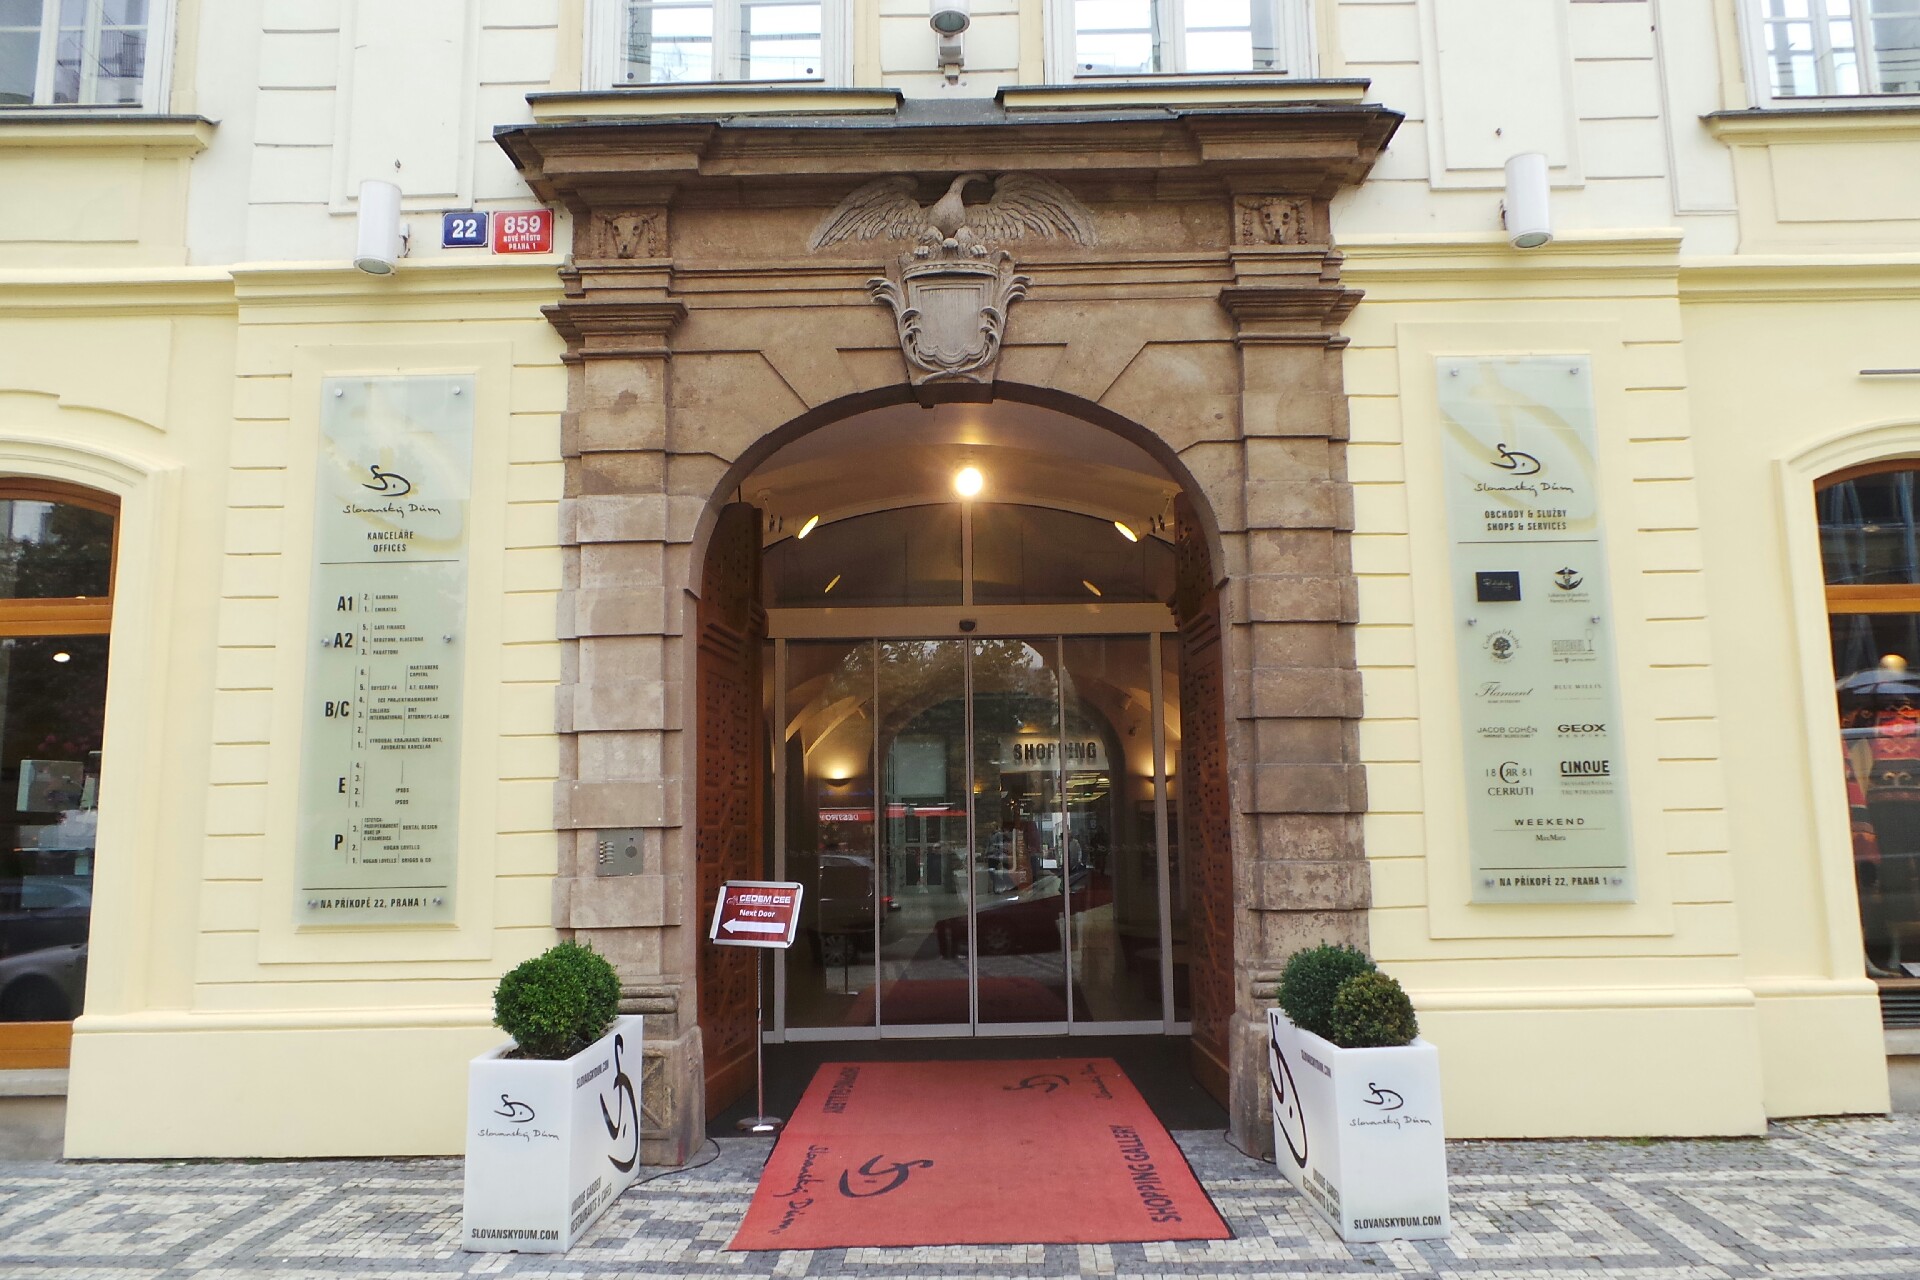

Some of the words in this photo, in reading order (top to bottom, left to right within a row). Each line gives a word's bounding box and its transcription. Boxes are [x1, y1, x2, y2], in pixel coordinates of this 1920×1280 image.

[453, 219, 477, 238] 22
[504, 215, 541, 233] 859
[504, 234, 518, 242] NOVÉ
[521, 234, 540, 242] MĚSTO
[1484, 510, 1524, 518] OBCHODY
[1537, 508, 1566, 518] SLUŽBY
[1487, 523, 1514, 531] SHOPS
[1527, 522, 1567, 530] SERVICES
[367, 529, 414, 540] KANCELÁŘE
[373, 544, 407, 553] OFFICES
[337, 596, 352, 611] A1
[334, 633, 352, 648] A2
[325, 701, 350, 717] B/C
[1558, 724, 1606, 733] GEOX
[1560, 760, 1610, 773] CINQUE
[338, 778, 346, 793] E
[1488, 787, 1533, 796] CERRUTI
[1515, 818, 1585, 826] WEEKEND
[334, 835, 343, 850] P
[1499, 878, 1511, 887] NA
[1555, 878, 1568, 886] 22,
[1572, 877, 1600, 885] PRAHA
[320, 900, 332, 908] NA
[374, 899, 387, 908] 22,
[391, 898, 419, 907] PRAHA
[422, 898, 427, 906] 1
[739, 895, 772, 904] CEDEM
[773, 895, 791, 904] CEE
[739, 909, 757, 917] Next
[1109, 1125, 1150, 1161] GALLERY
[1128, 1163, 1182, 1222] SHOPPING
[1354, 1216, 1441, 1229] SLOVANSKYDUM.COM
[471, 1229, 559, 1241] SLOVANSKYDUM.COM
